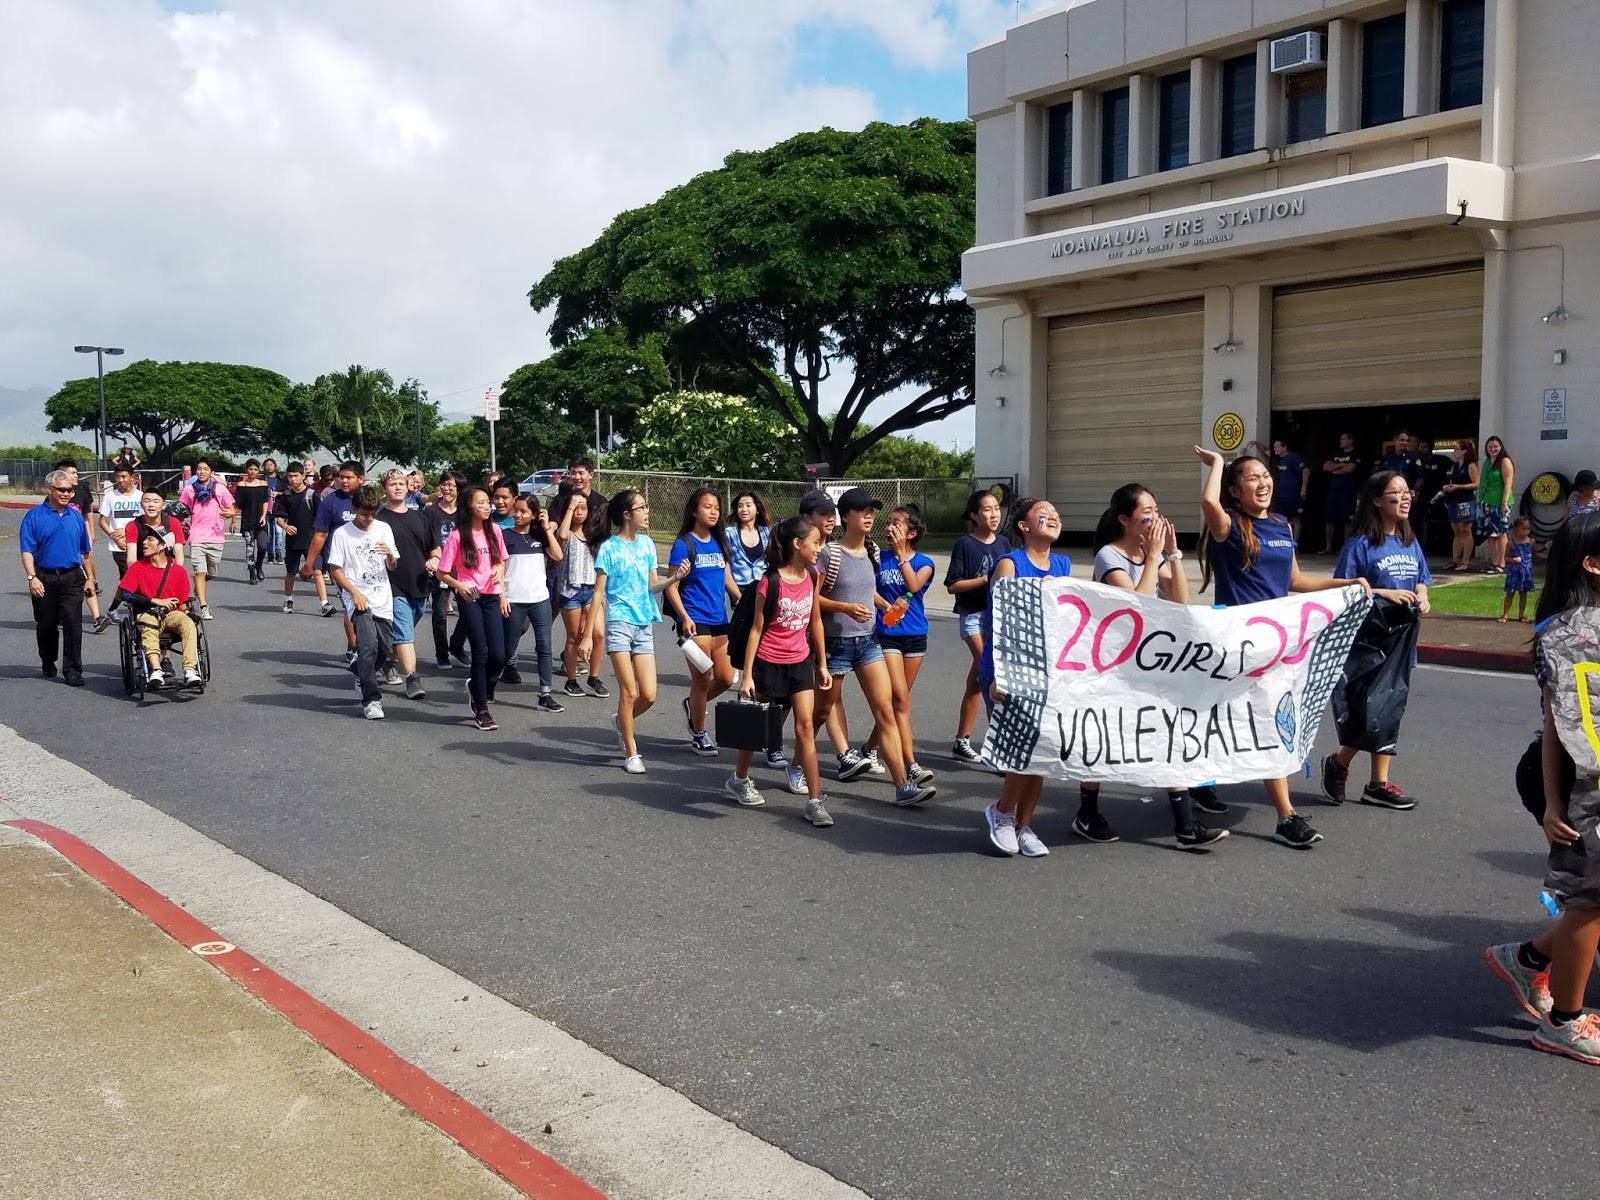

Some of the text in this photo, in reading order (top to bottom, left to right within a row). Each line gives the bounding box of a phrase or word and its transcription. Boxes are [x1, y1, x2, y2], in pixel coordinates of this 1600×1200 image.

[1050, 198, 1305, 258] MOANALUA FIRE STATION
[1106, 233, 1233, 259] CITY AND COUNTY OF HONOLULU
[1222, 427, 1232, 437] 30
[1541, 484, 1551, 494] 30
[1055, 594, 1144, 673] 20
[1135, 630, 1255, 681] GIRLS
[1057, 701, 1280, 767] VOLLEYBALL
